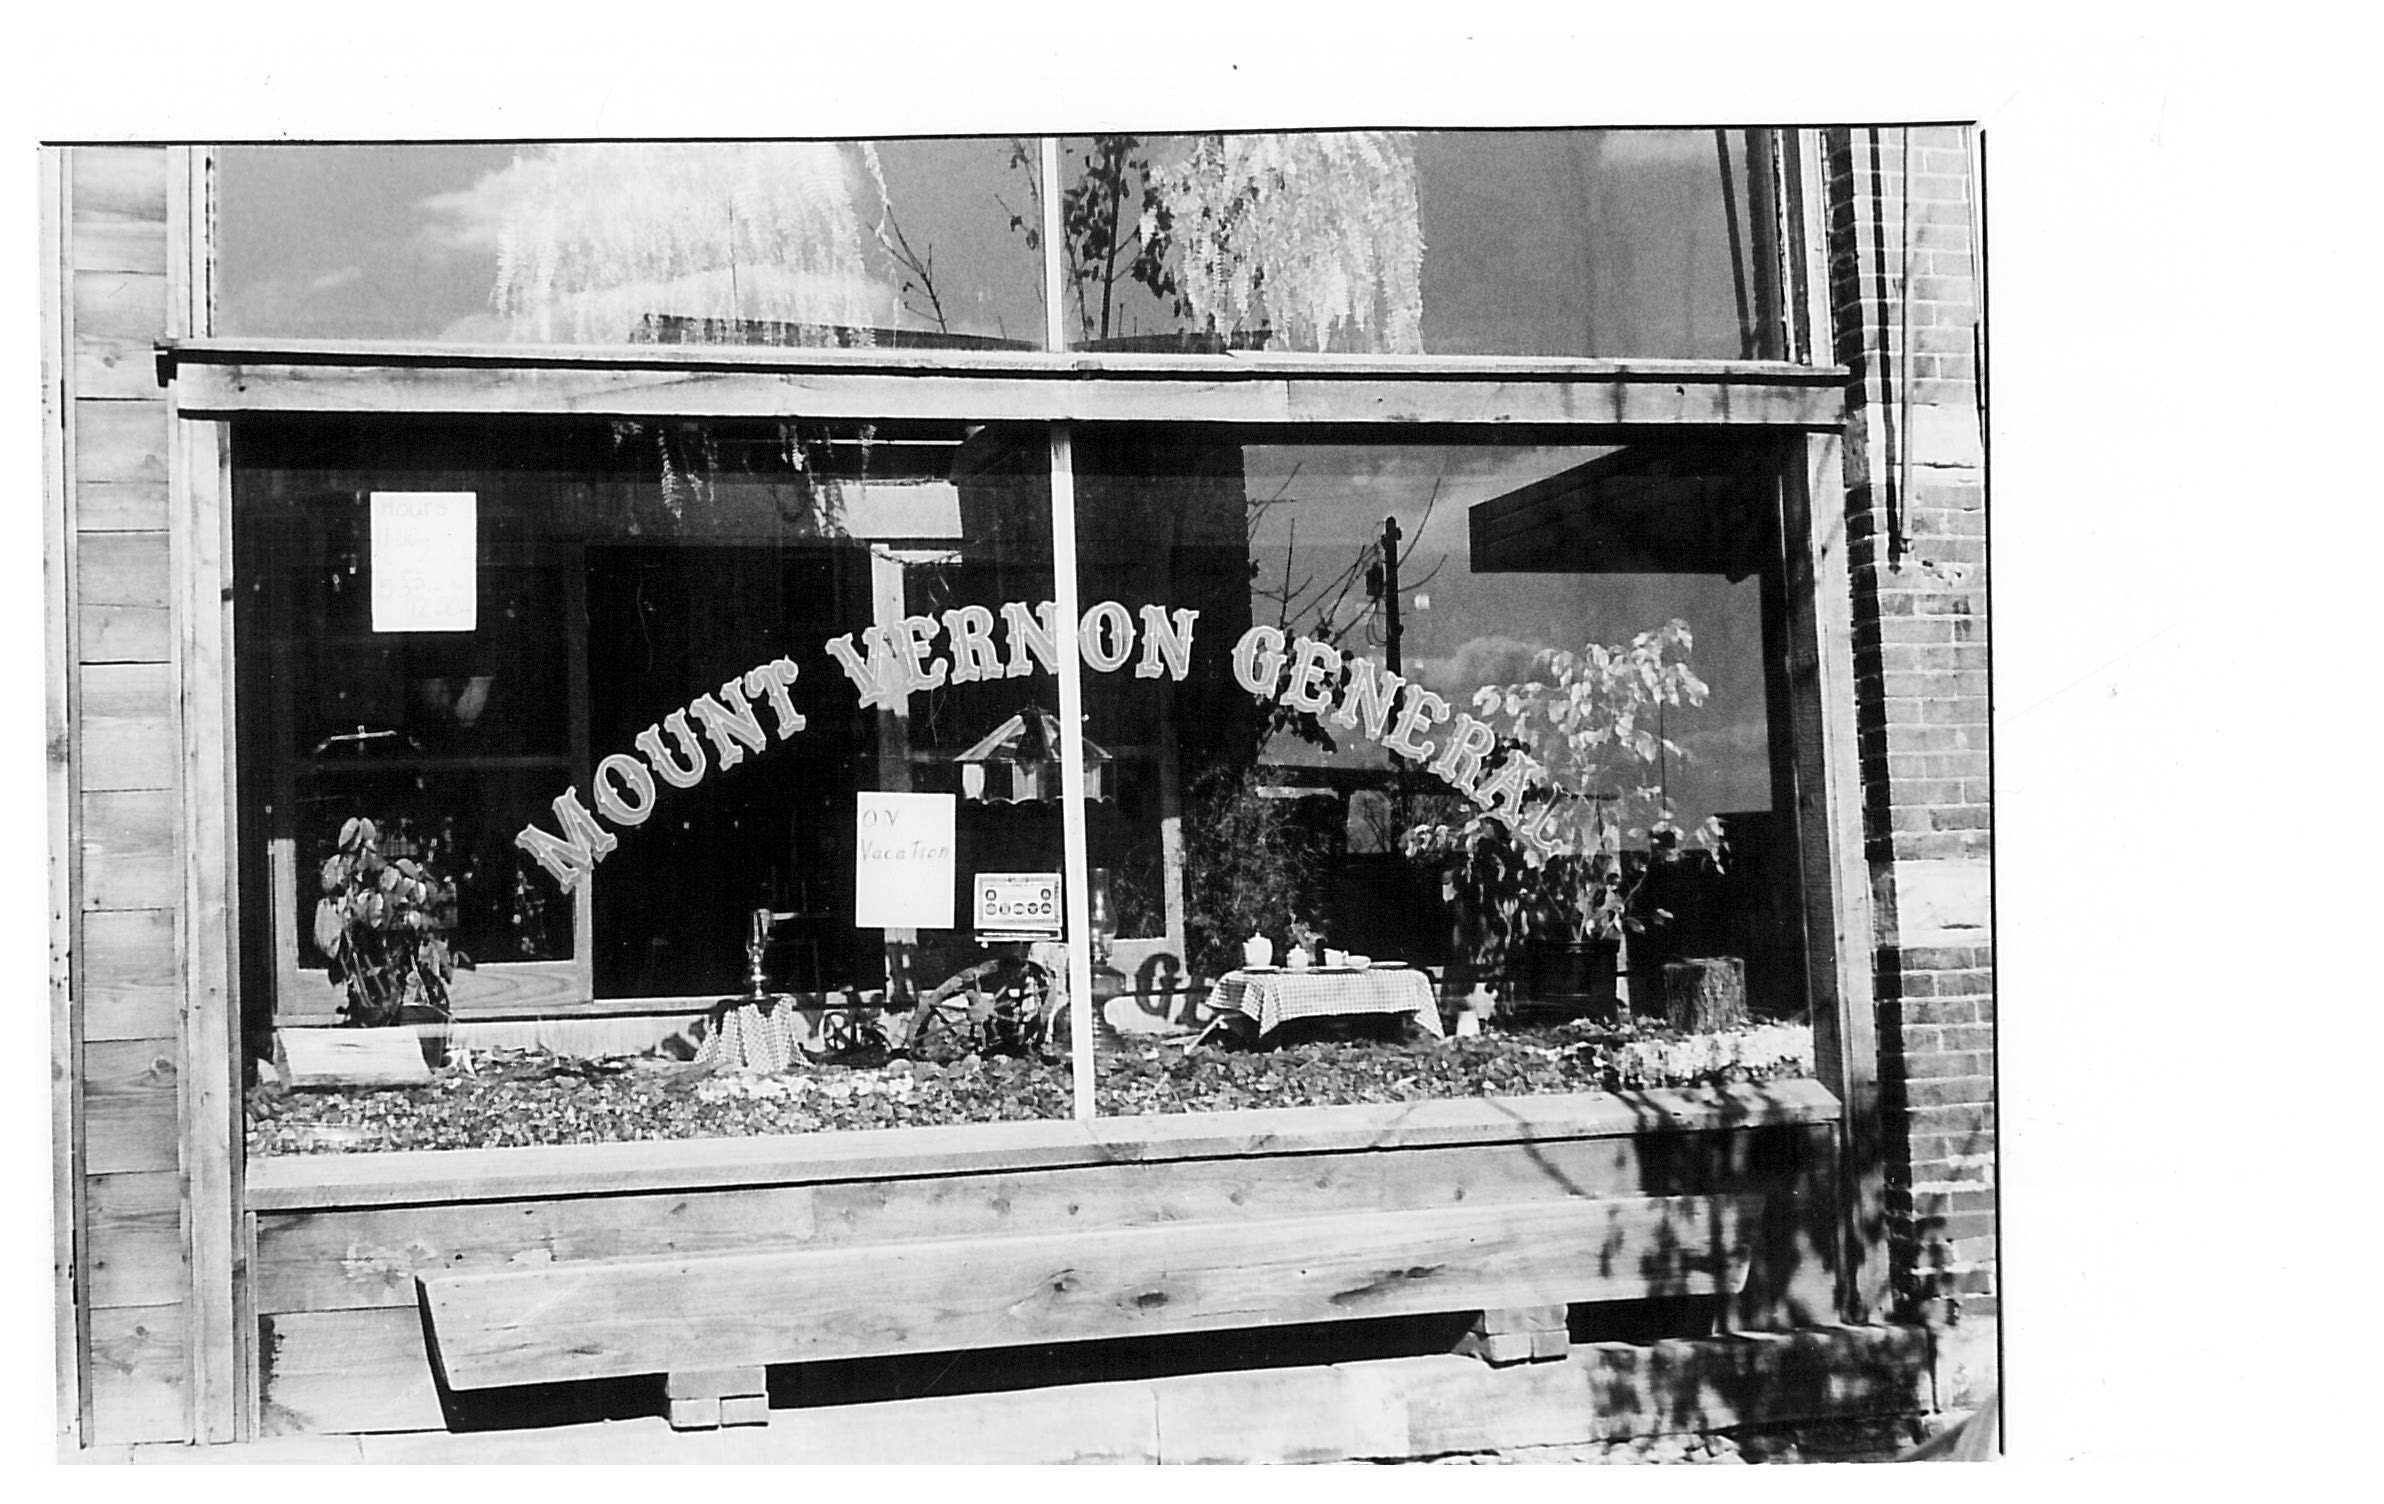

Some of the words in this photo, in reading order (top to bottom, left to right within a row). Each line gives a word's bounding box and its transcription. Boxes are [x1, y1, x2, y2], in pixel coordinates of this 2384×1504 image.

[515, 655, 807, 895] MOUNT
[825, 600, 1200, 709] VERNON
[1231, 625, 1573, 858] GENERAL
